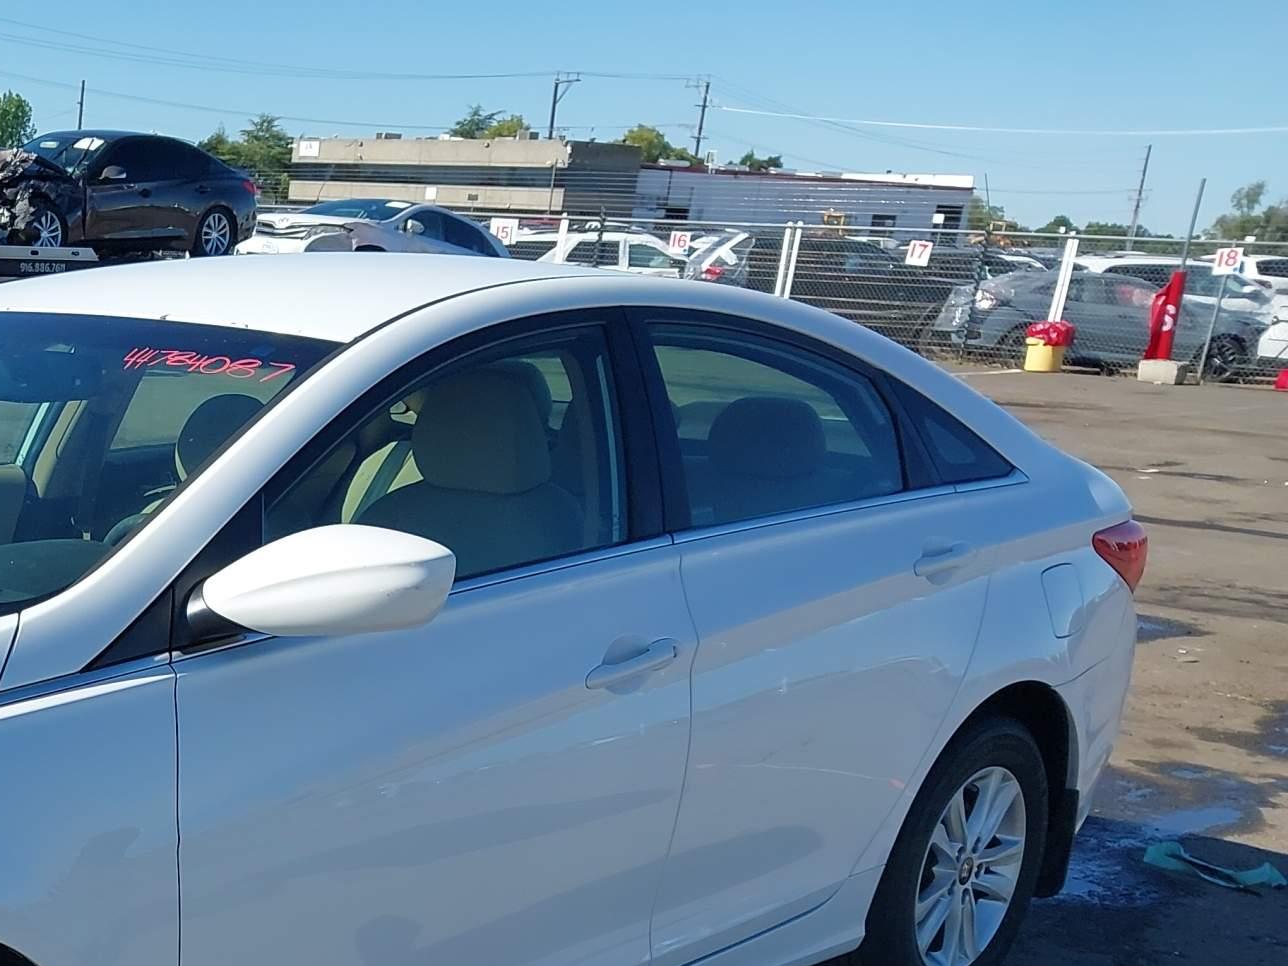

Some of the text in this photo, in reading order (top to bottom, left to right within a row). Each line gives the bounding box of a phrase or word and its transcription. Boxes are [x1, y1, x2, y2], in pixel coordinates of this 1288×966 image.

[495, 225, 510, 240] 15
[672, 233, 688, 249] 16
[910, 242, 929, 259] 17
[1217, 249, 1239, 267] 18
[123, 347, 296, 383] 44784087
